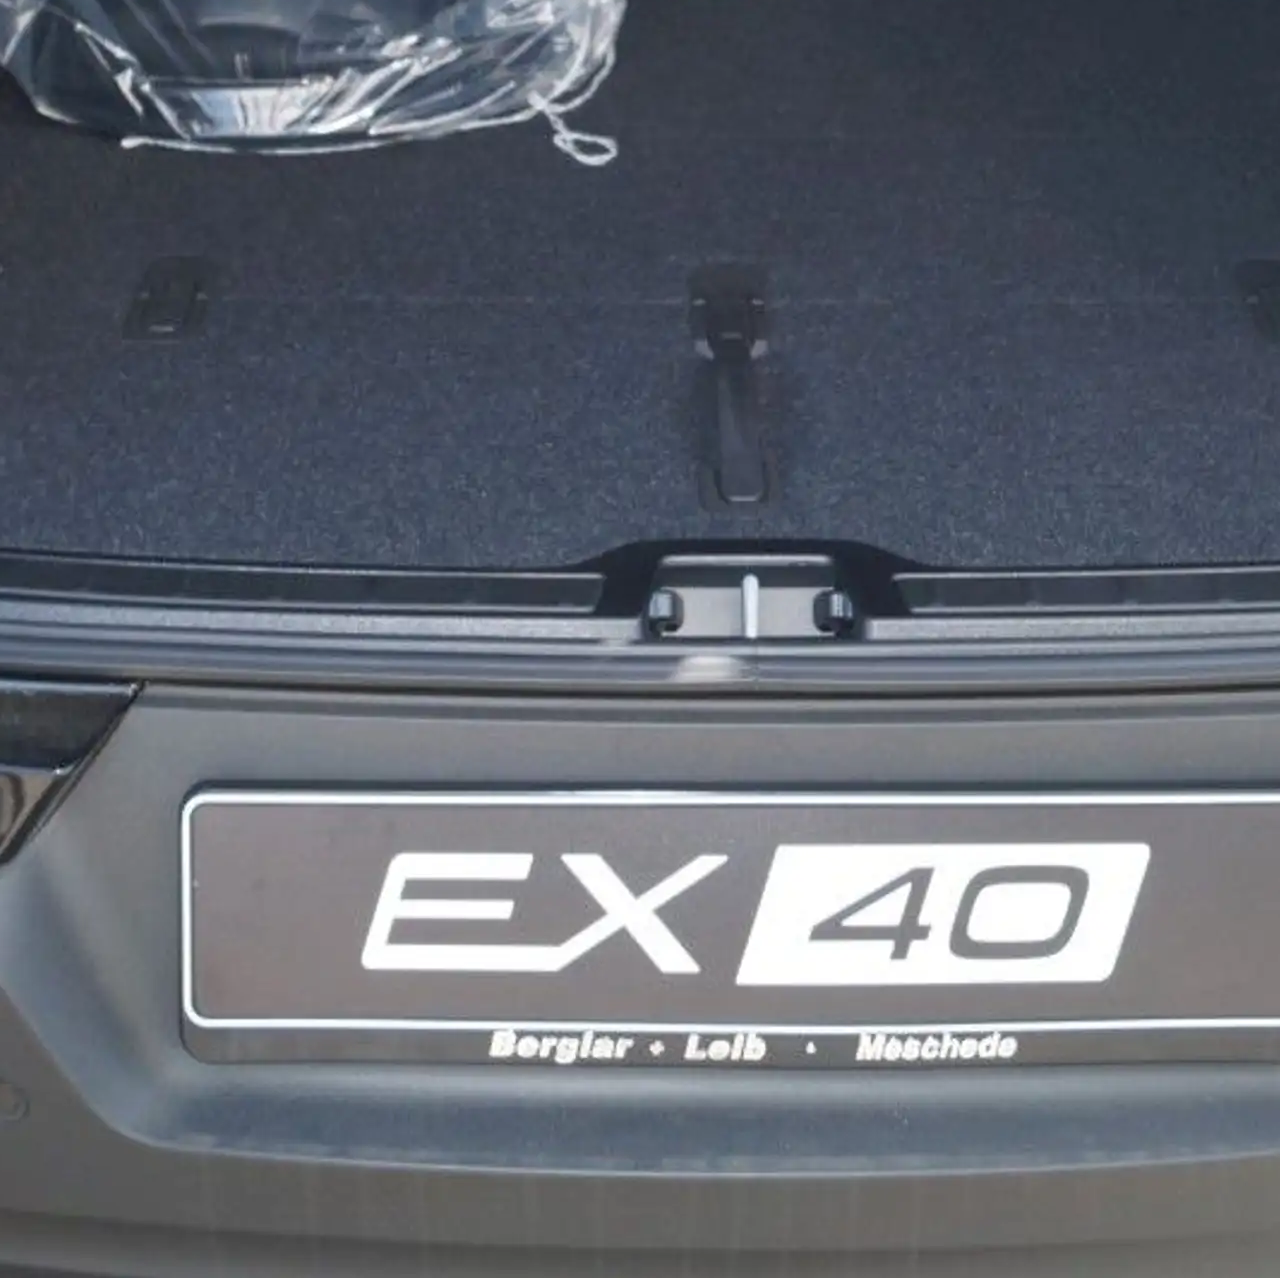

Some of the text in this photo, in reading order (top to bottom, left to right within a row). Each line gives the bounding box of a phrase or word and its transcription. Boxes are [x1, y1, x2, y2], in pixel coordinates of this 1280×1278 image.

[361, 852, 1091, 974] EX 40
[855, 1031, 1018, 1062] Meschede
